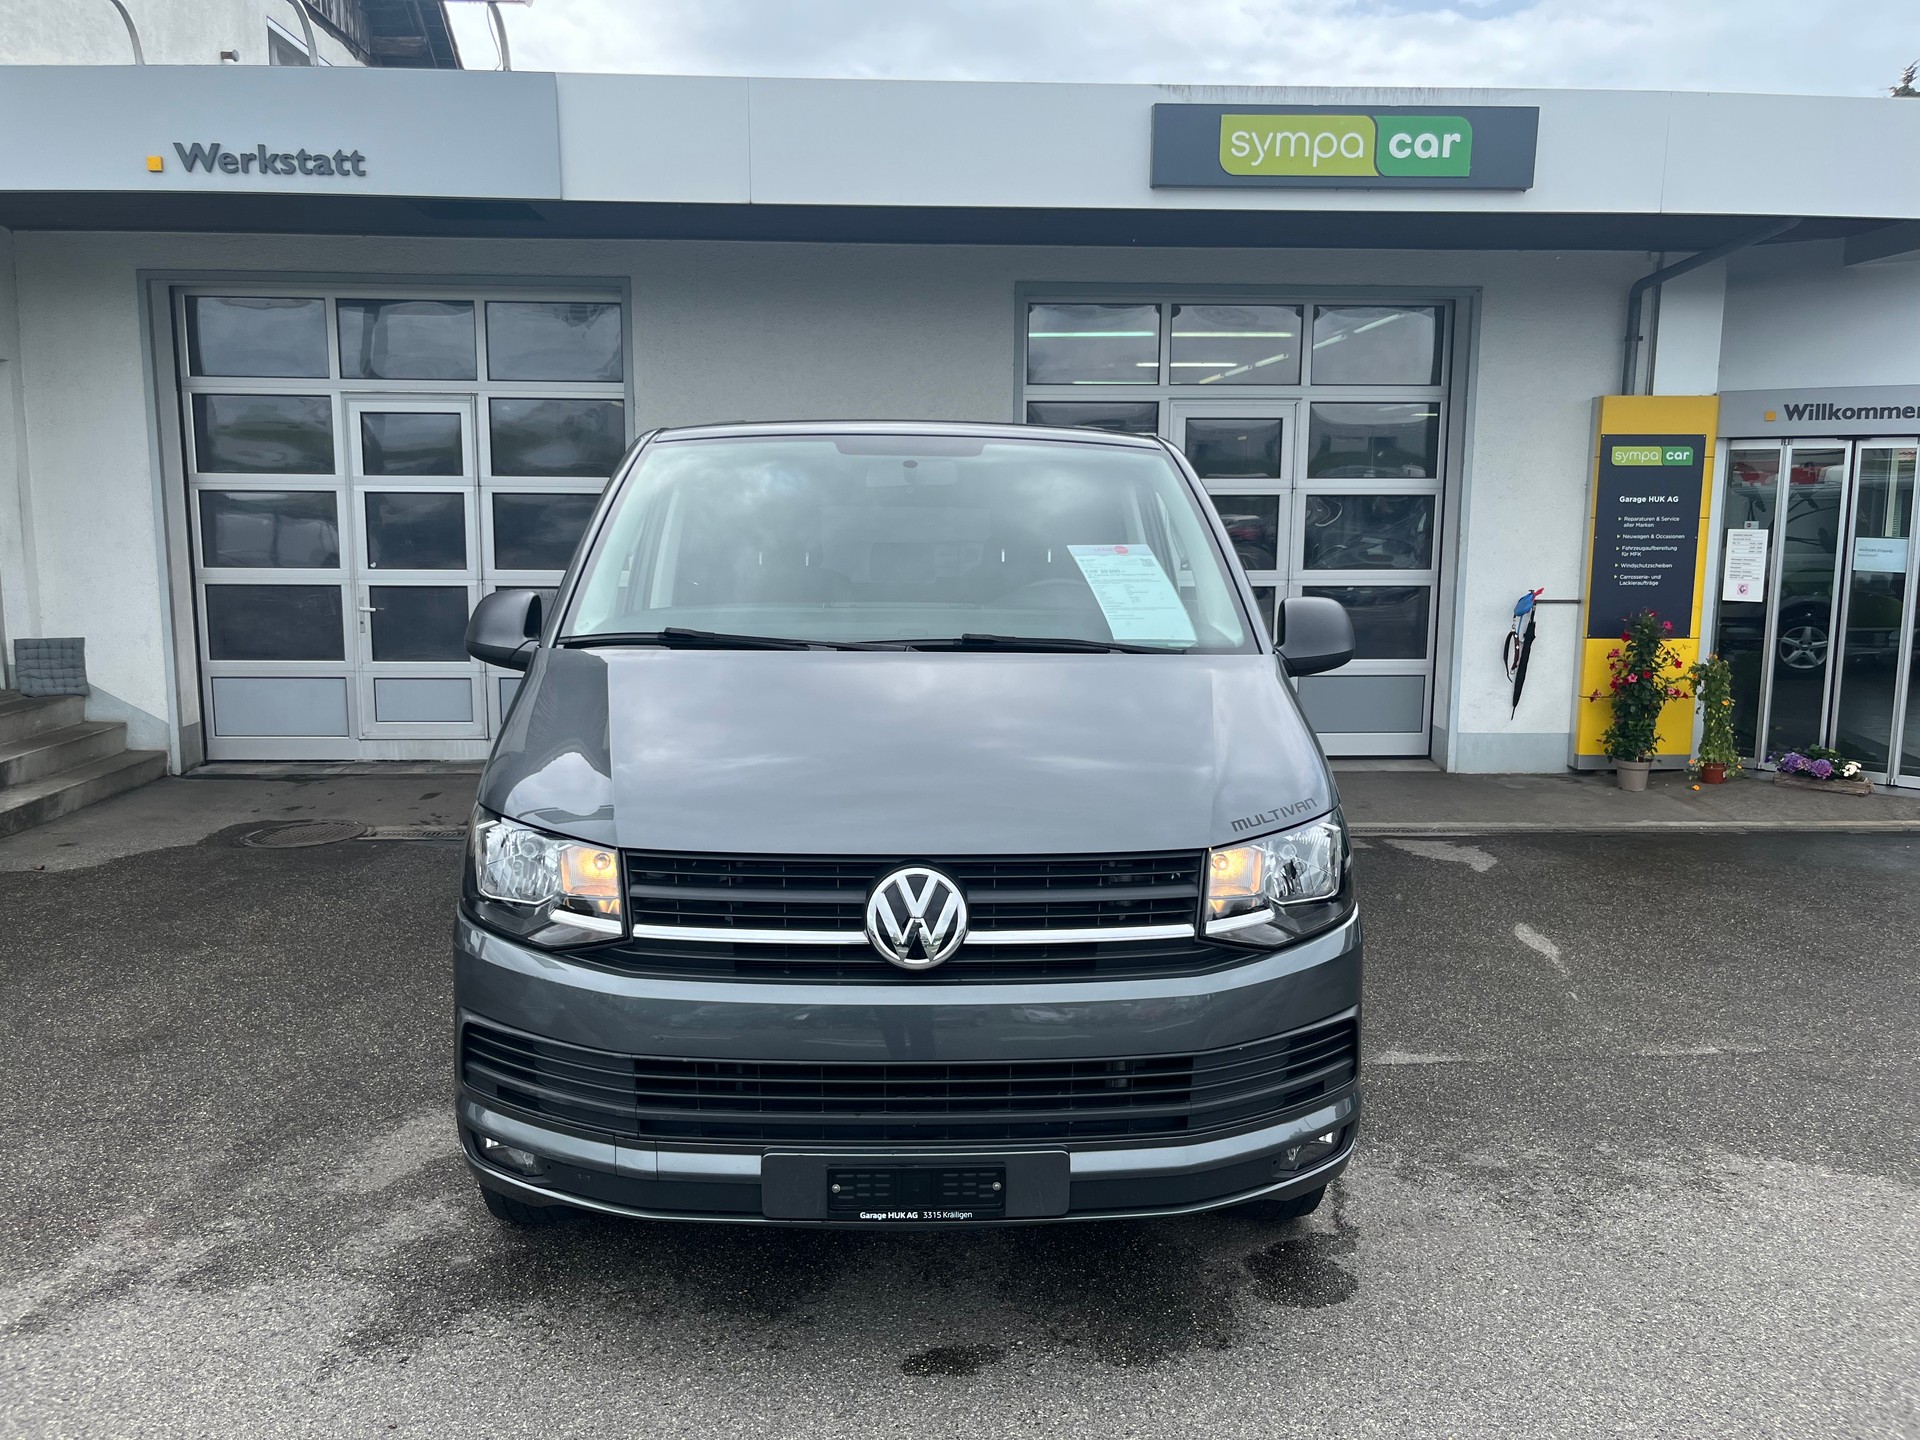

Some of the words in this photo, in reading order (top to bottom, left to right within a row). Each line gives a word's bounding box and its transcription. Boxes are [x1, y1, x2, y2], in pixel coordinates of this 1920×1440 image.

[172, 142, 367, 177] Werkstatt
[1231, 131, 1364, 168] sympa
[1388, 132, 1461, 159] car
[1615, 451, 1659, 464] sympa
[1665, 451, 1690, 460] car
[1619, 496, 1647, 504] Garage
[1230, 797, 1318, 832] MULTIVAN
[859, 1211, 887, 1220] Garage
[887, 1211, 906, 1219] HUK
[906, 1211, 919, 1219] AG
[922, 1211, 942, 1219] 3315
